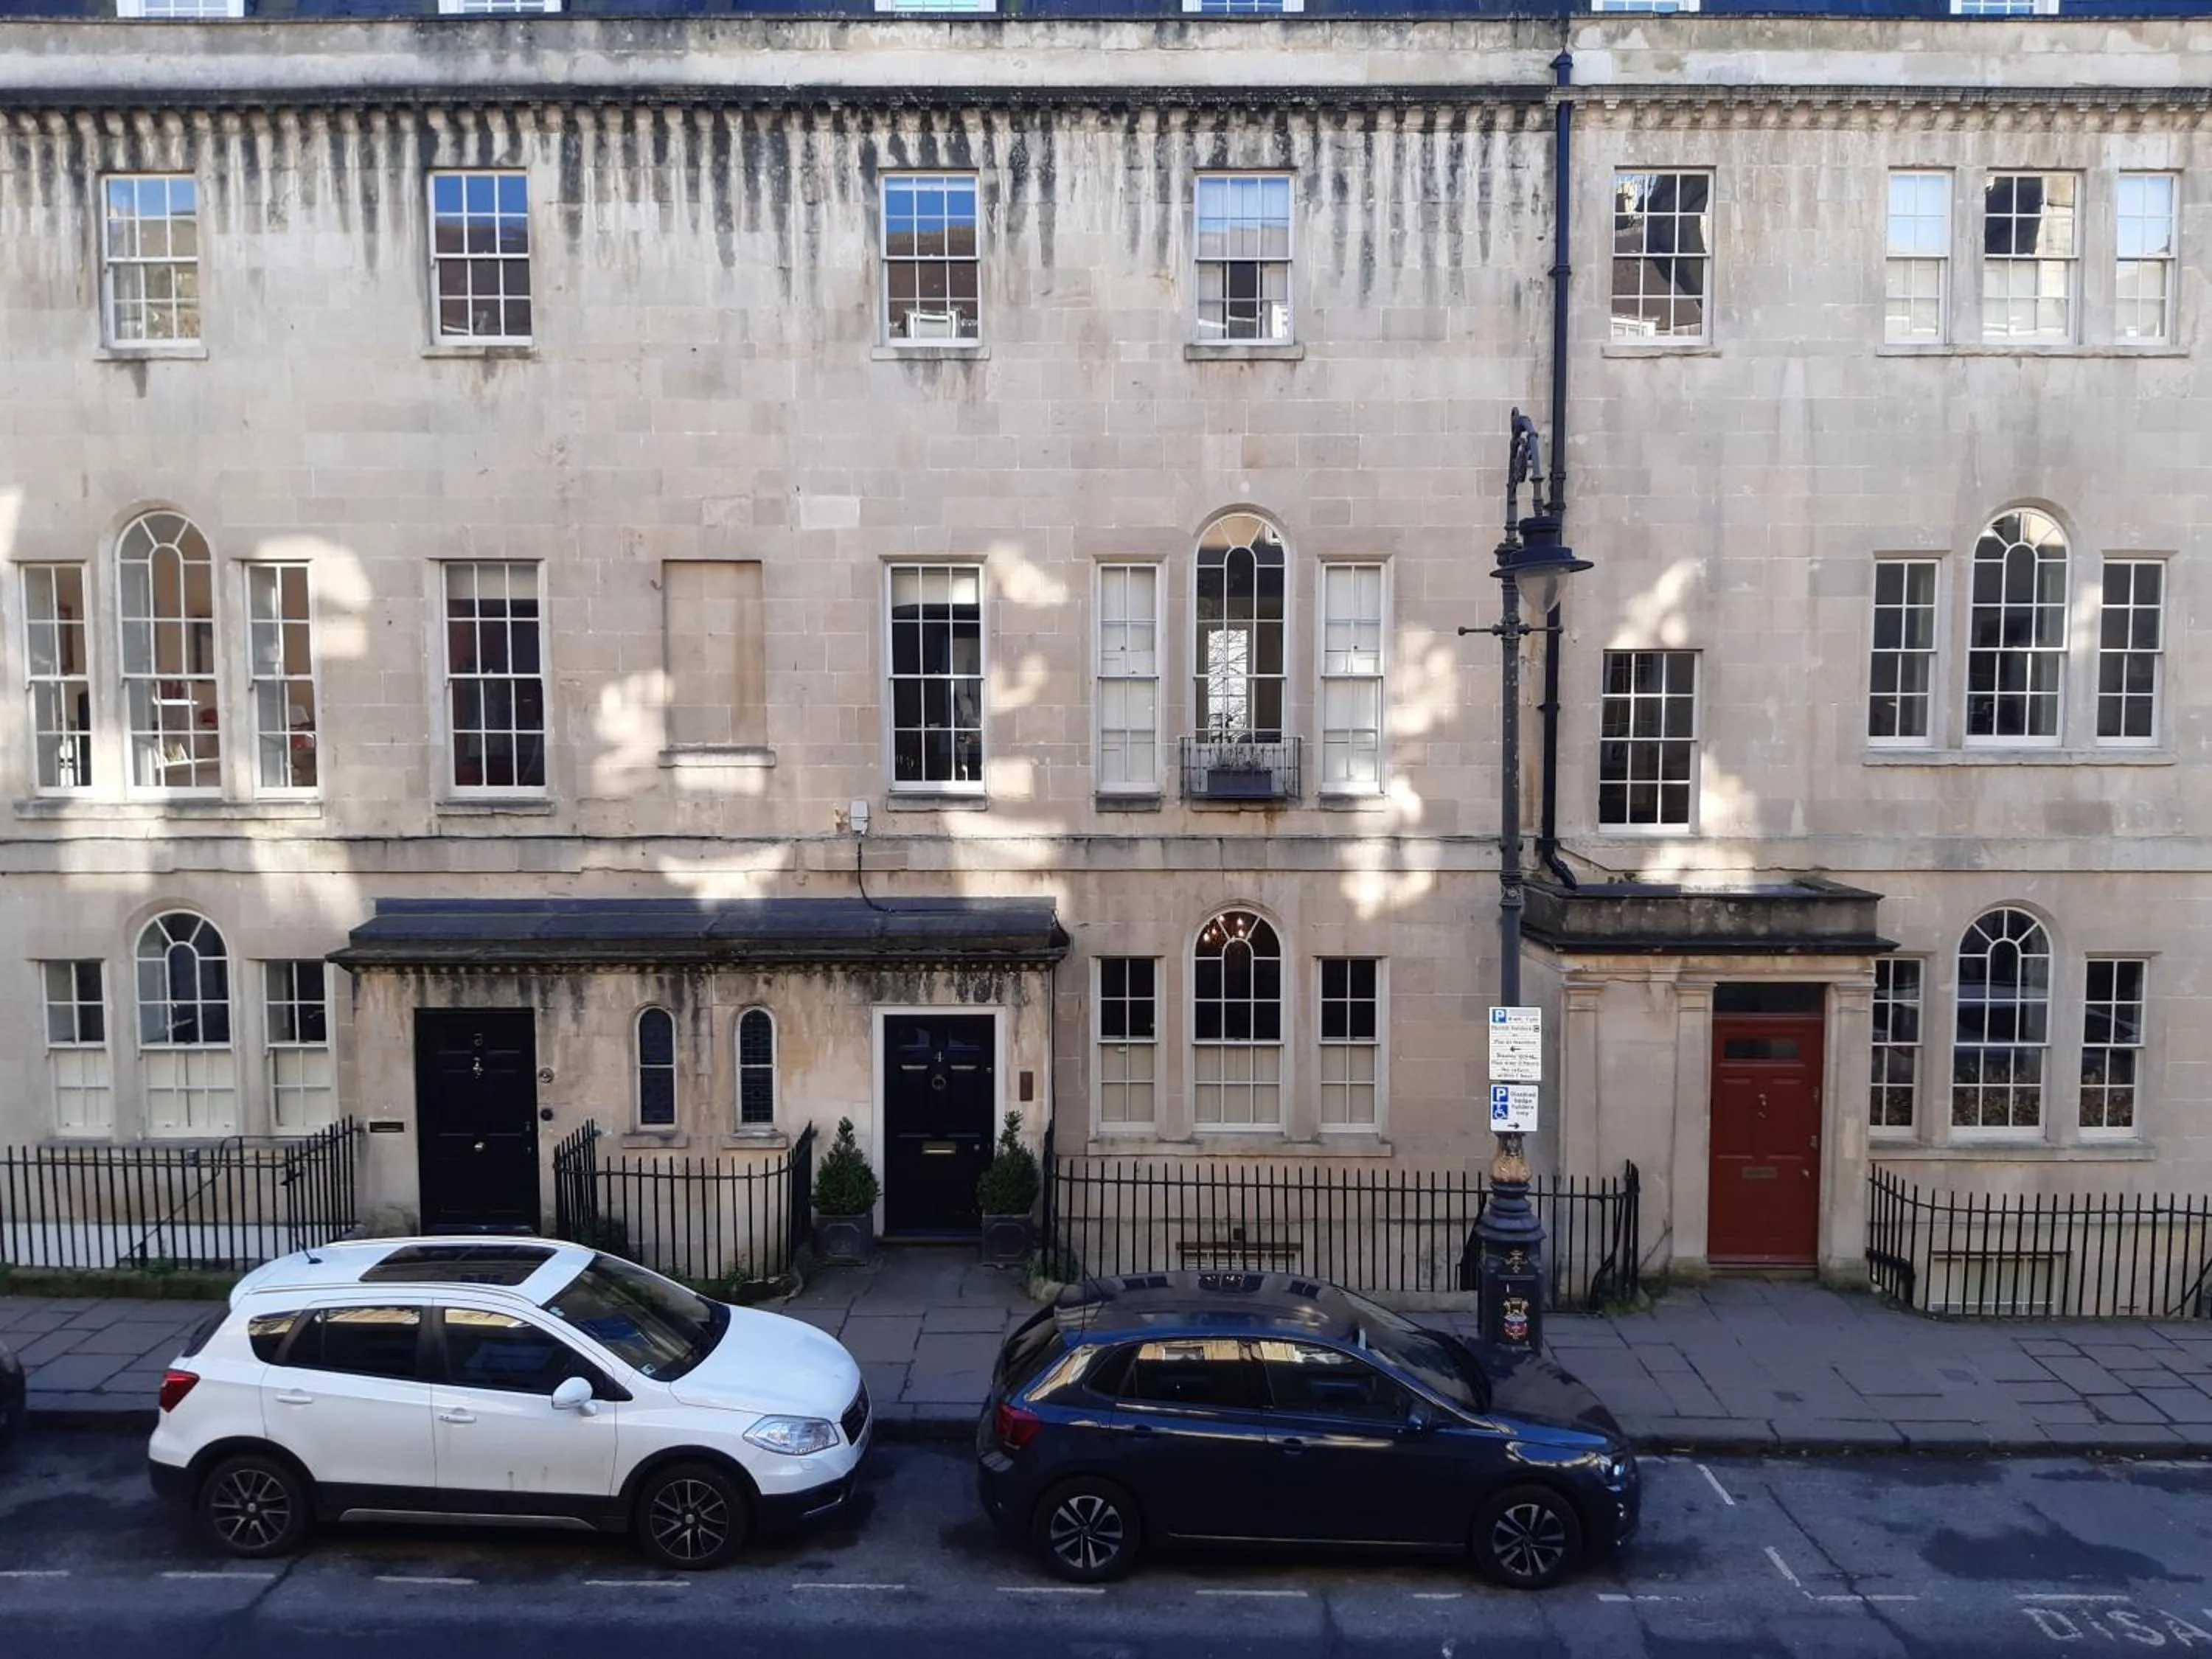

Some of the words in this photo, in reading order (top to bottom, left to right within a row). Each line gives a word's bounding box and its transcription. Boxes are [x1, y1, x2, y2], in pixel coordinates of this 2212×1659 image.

[1495, 1009, 1505, 1023] P
[932, 1051, 945, 1062] 4
[1497, 1088, 1506, 1102] P
[2023, 1607, 2212, 1647] DISA
